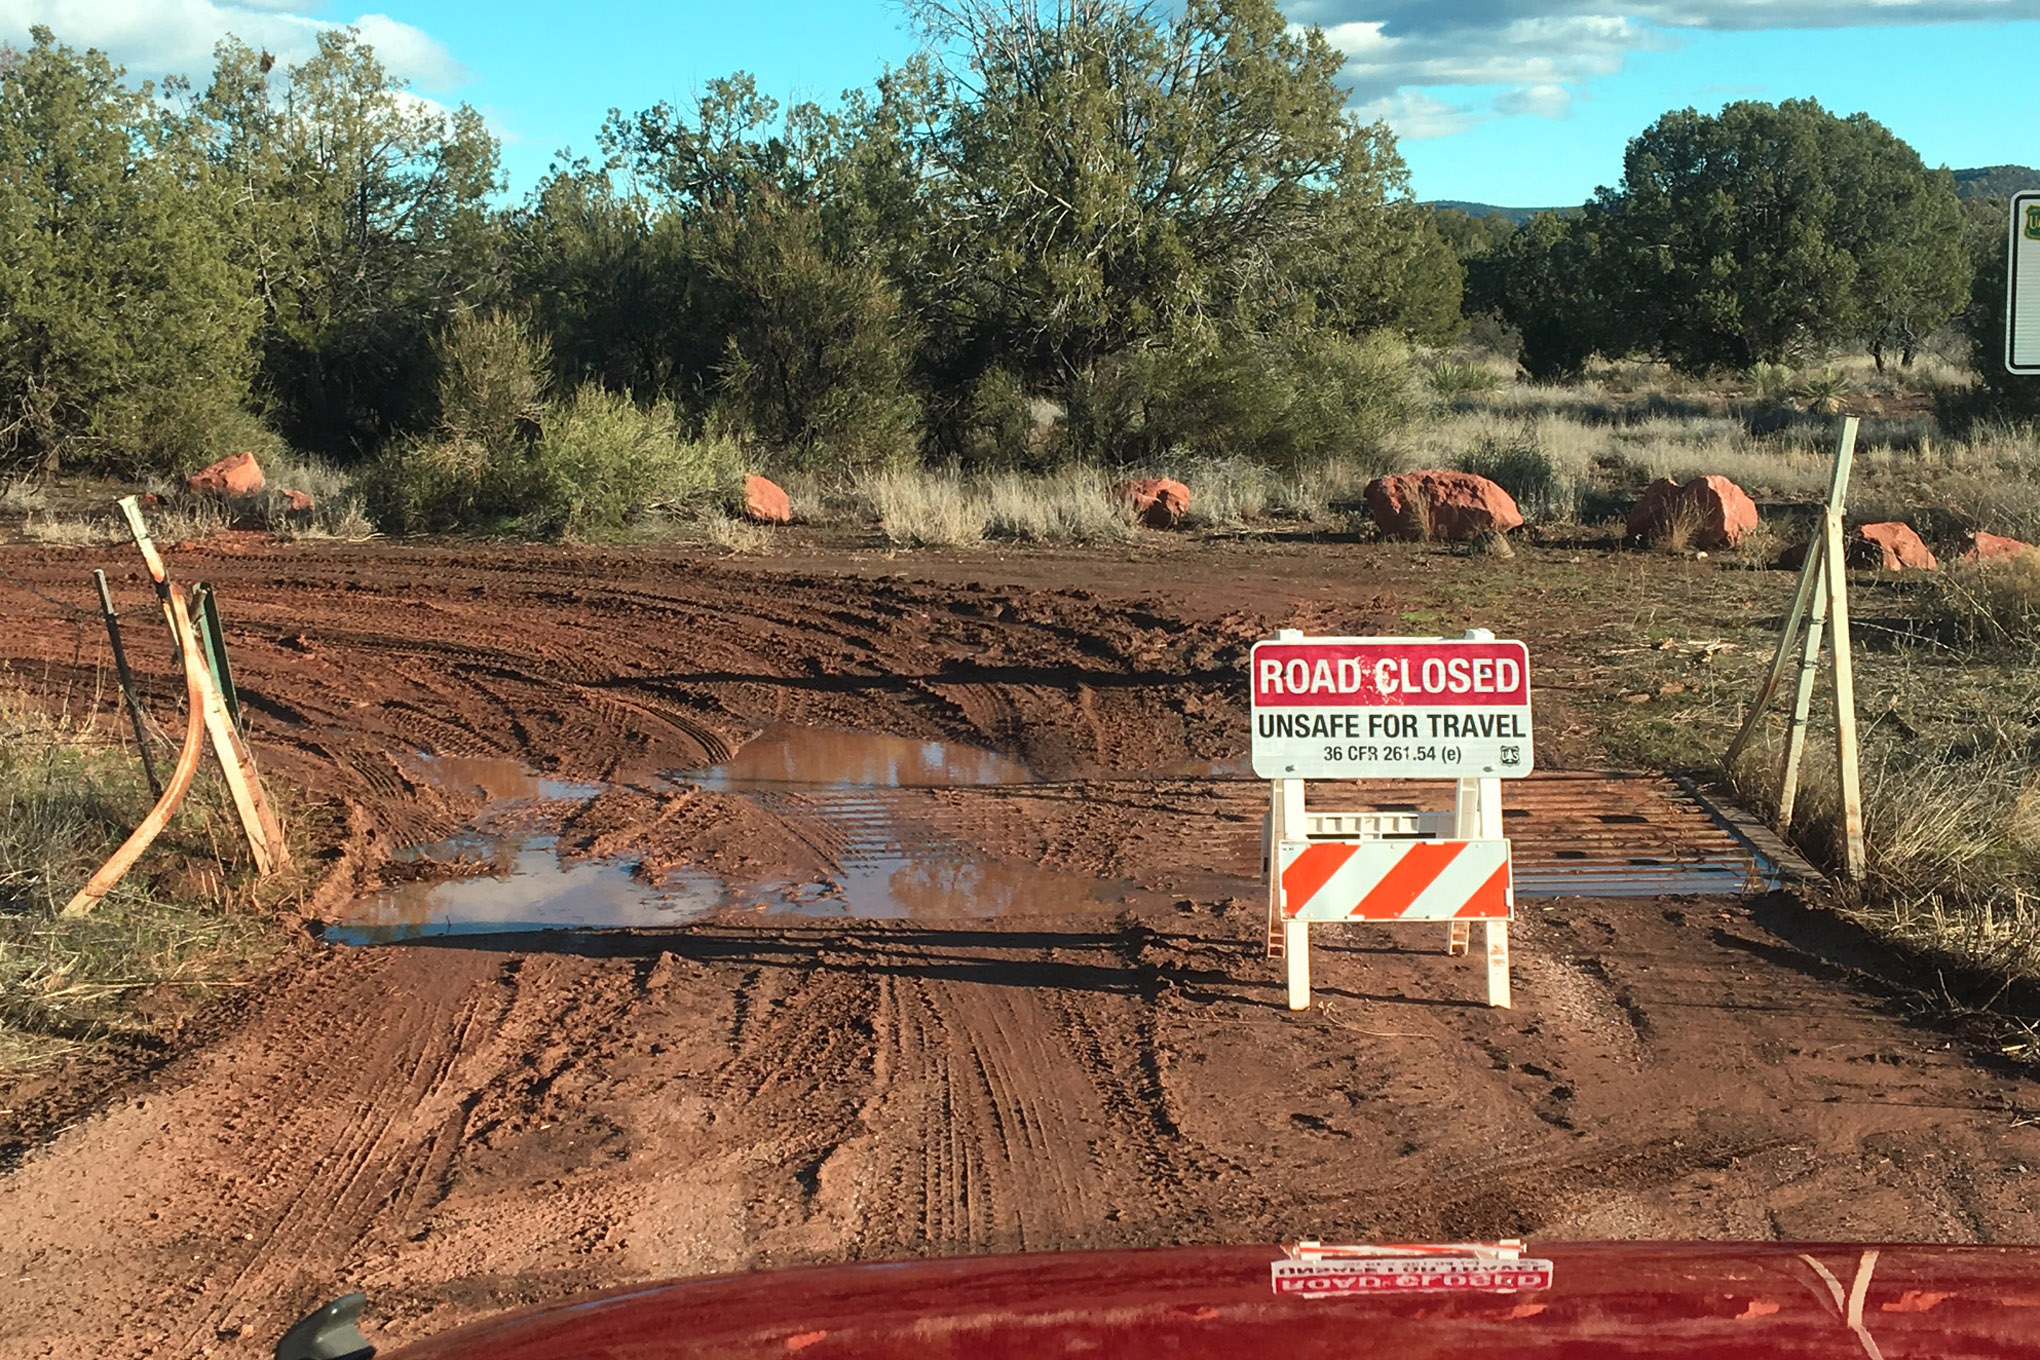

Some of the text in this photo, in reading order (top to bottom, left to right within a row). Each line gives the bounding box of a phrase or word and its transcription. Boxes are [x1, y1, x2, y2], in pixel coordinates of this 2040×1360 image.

[1260, 658, 1520, 694] ROAD CLOSED
[1258, 714, 1526, 738] UNSAFE FOR TRAVEL
[1323, 746, 1462, 763] 36 CFR 261.54 (e)
